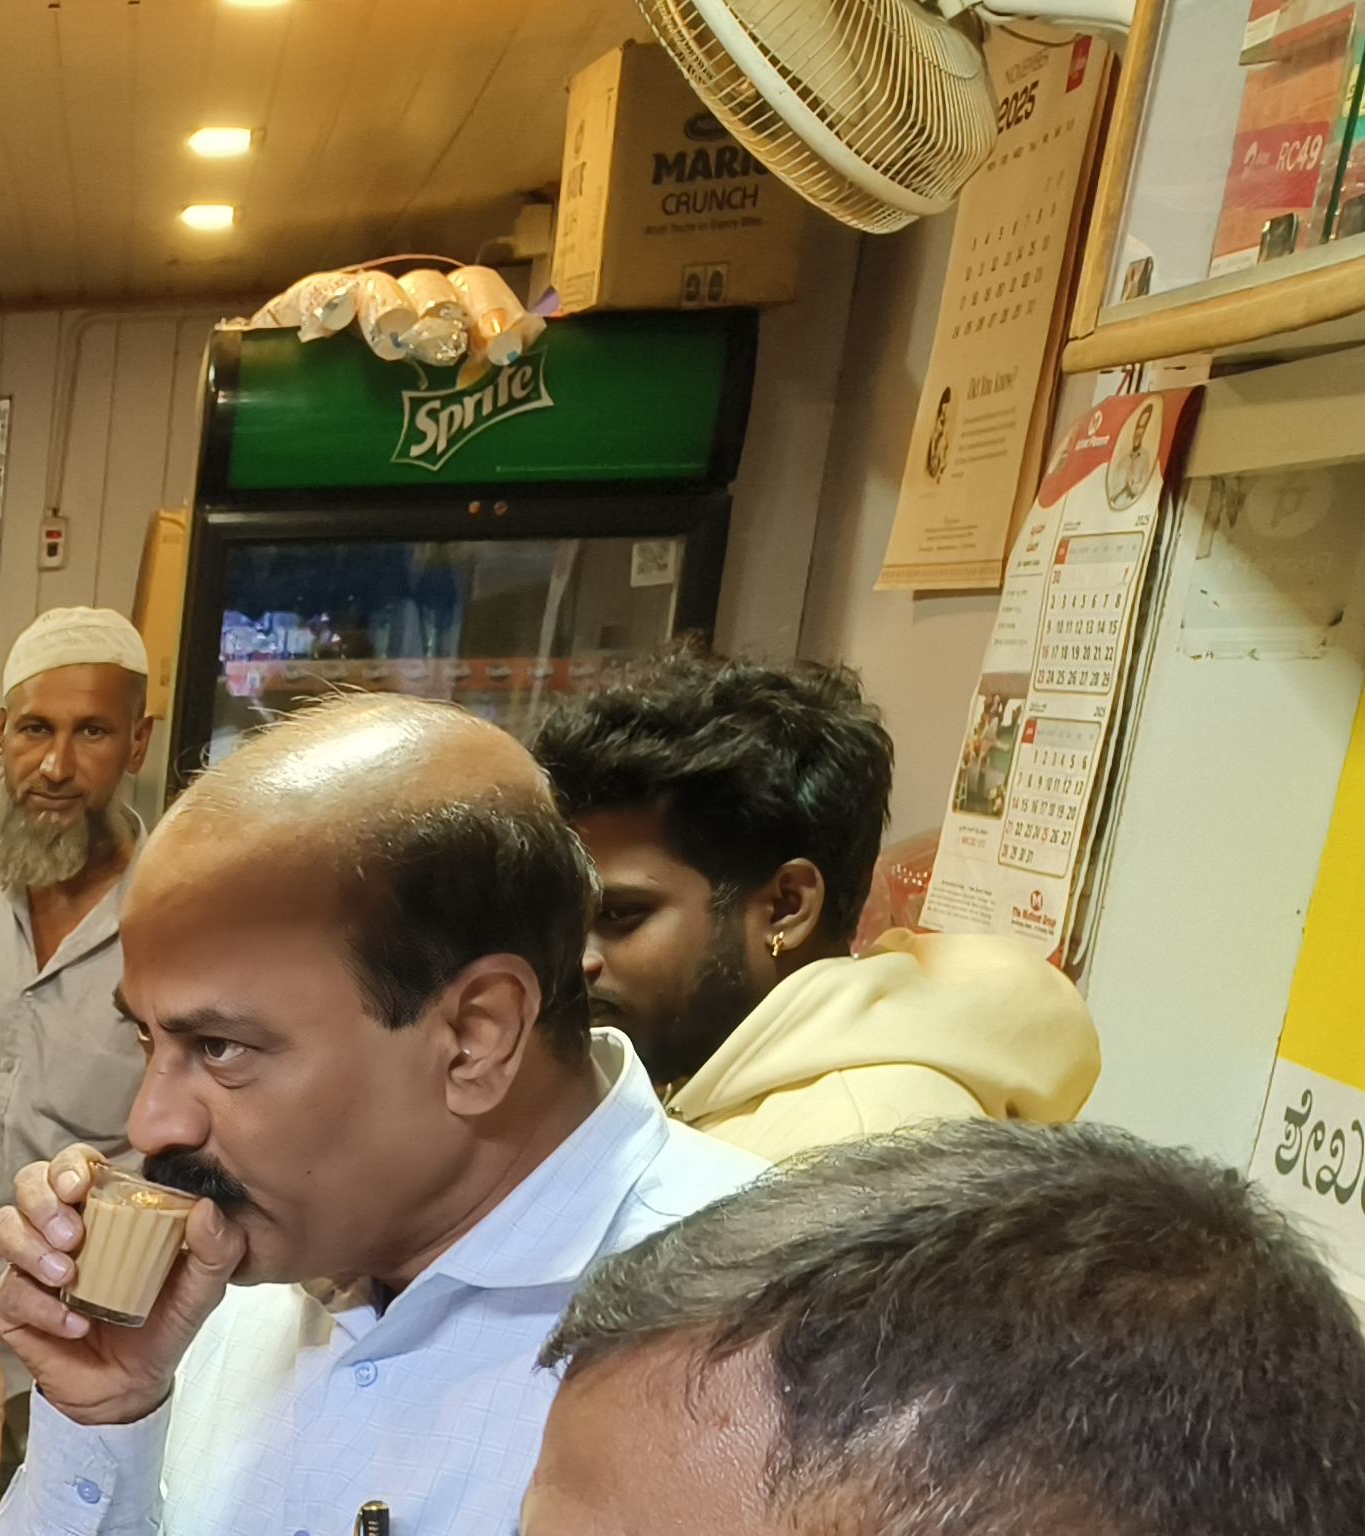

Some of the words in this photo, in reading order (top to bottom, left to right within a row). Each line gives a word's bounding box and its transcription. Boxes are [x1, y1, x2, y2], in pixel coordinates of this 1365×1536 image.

[998, 80, 1039, 135] 2025
[661, 184, 759, 216] CRUNCH
[409, 365, 534, 458] Sprite
